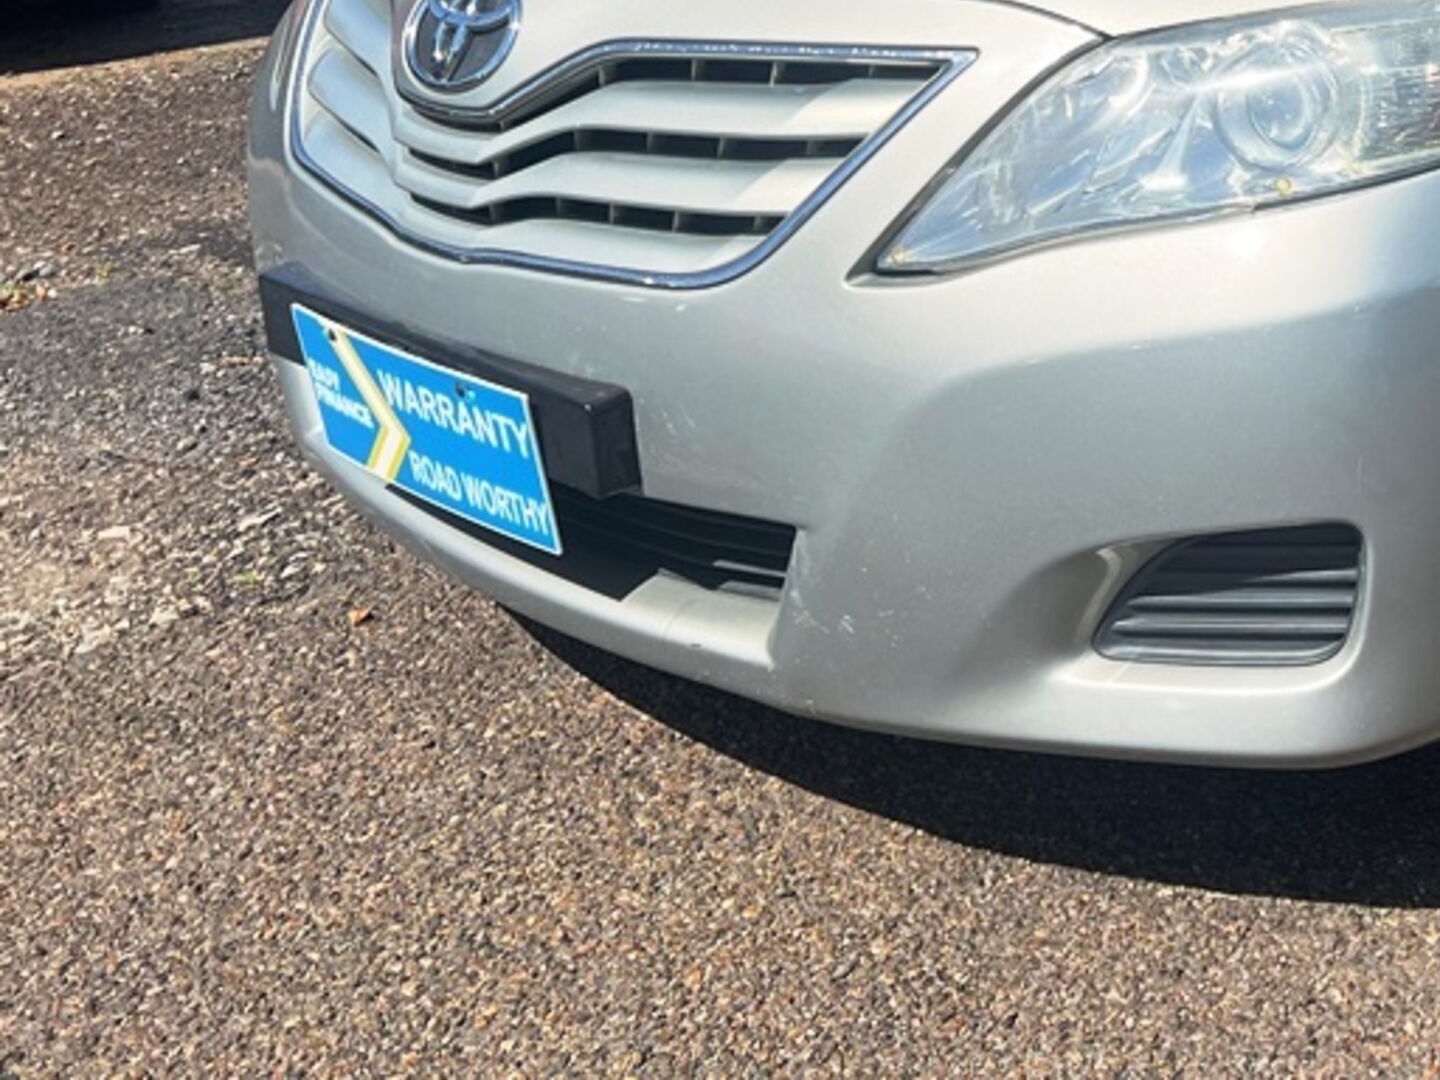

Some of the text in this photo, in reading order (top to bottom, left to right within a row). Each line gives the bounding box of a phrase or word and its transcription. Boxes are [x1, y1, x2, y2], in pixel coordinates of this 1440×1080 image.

[376, 368, 531, 460] WARRANTY
[407, 449, 551, 538] ROAD WORTHY
